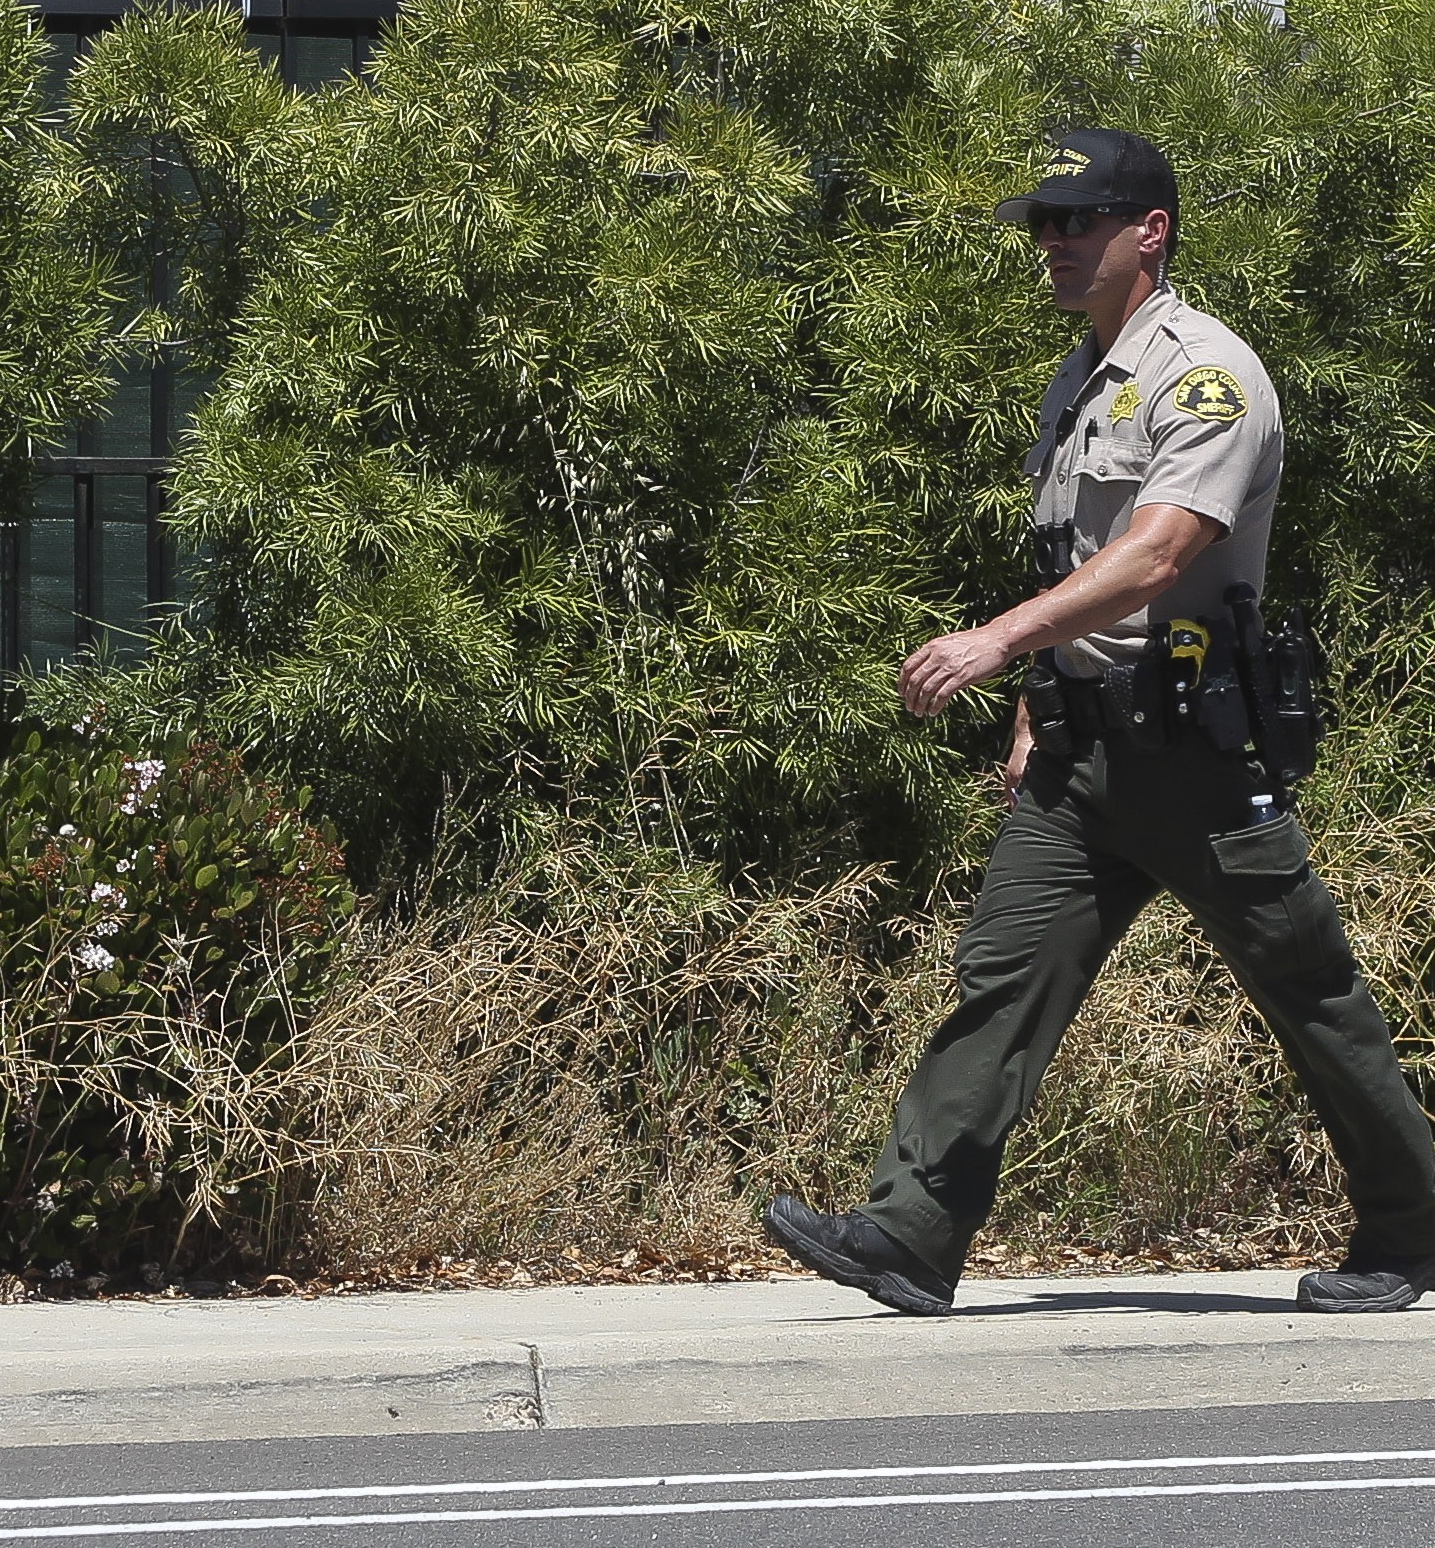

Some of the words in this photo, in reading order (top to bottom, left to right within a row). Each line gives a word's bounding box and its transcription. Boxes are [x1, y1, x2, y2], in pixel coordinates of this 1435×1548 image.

[1177, 384, 1194, 403] SAN
[1187, 370, 1218, 386] DIEGO
[1218, 373, 1247, 407] COUNTY
[1196, 402, 1235, 415] SHERIFF
